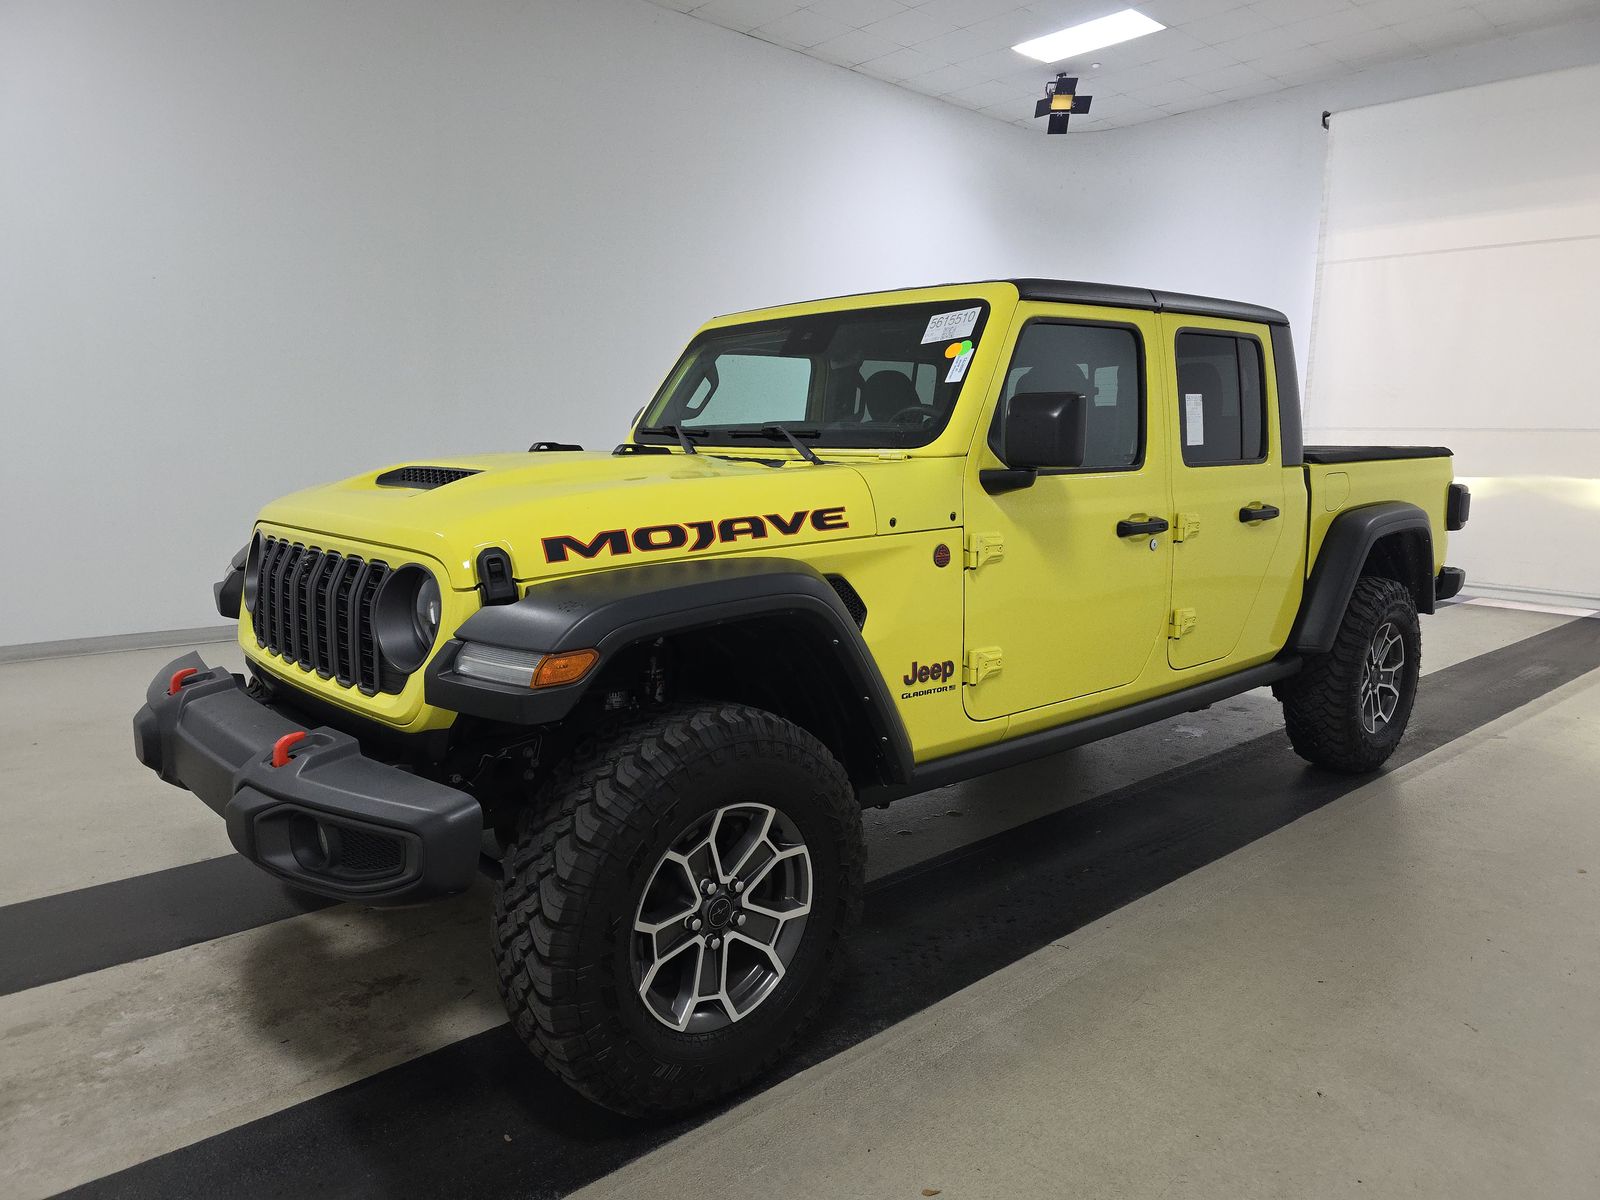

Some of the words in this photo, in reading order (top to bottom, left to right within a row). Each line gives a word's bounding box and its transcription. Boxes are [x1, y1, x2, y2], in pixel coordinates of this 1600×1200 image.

[541, 506, 849, 564] MOJAVE
[903, 660, 955, 686] Jeep
[901, 686, 948, 700] GLADIATOR
